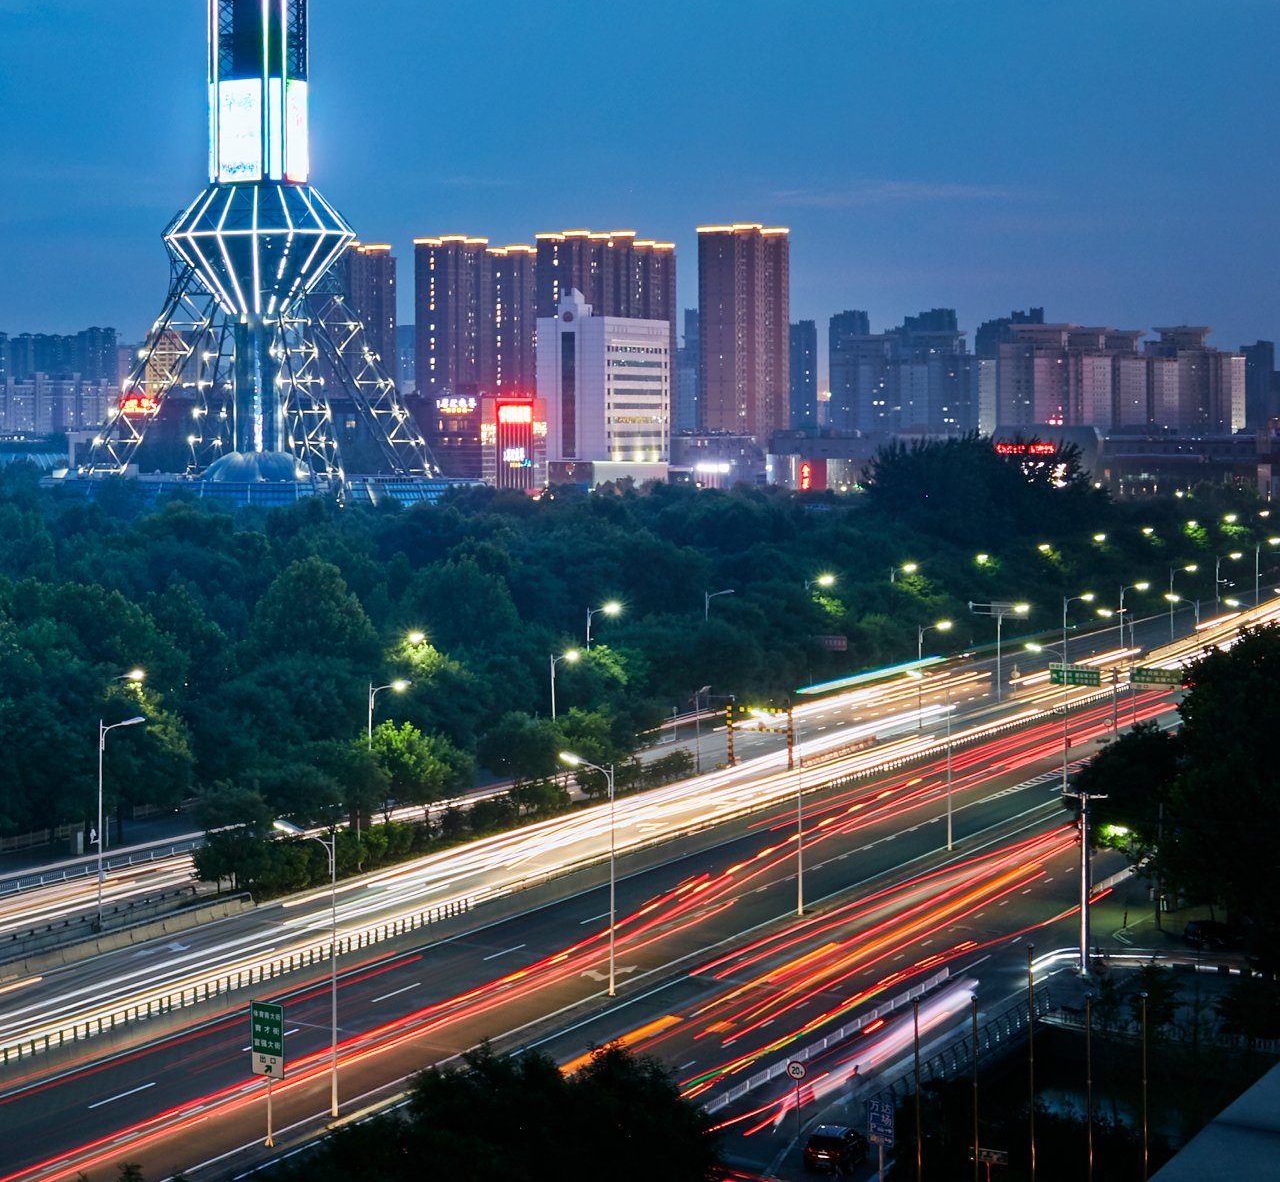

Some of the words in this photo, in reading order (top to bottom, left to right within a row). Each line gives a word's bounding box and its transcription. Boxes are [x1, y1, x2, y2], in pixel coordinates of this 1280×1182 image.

[255, 1024, 280, 1036] 育才街
[254, 1038, 281, 1050] 富强大街
[260, 1055, 276, 1064] 出口
[870, 1100, 892, 1114] 万达
[870, 1113, 892, 1126] 广场
